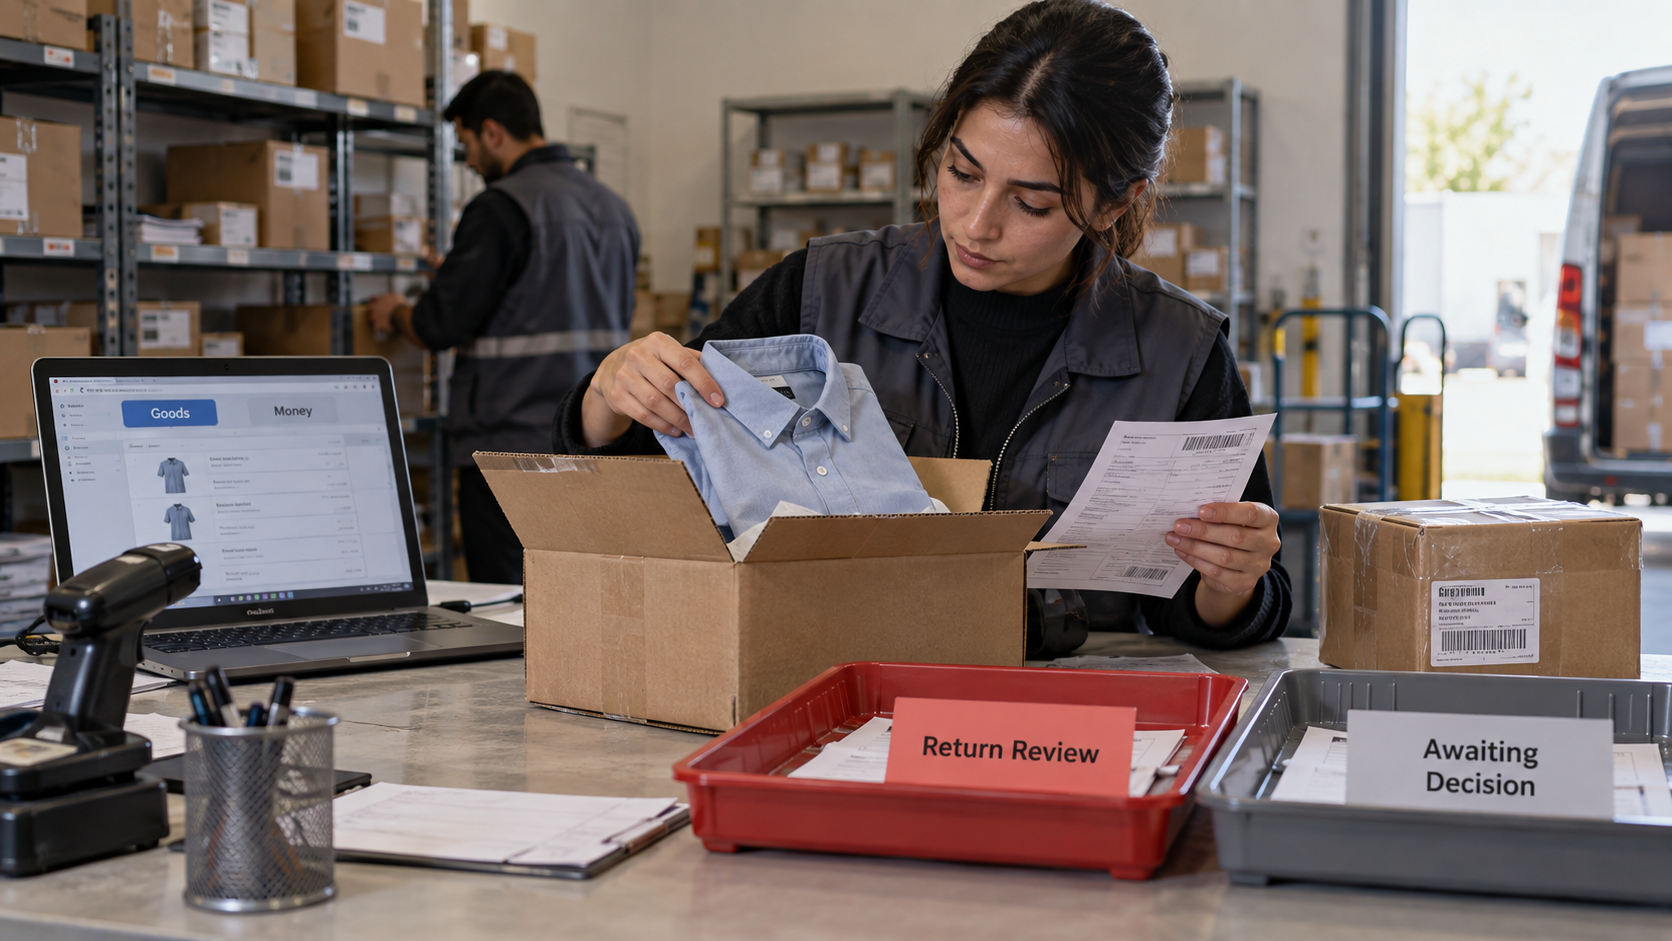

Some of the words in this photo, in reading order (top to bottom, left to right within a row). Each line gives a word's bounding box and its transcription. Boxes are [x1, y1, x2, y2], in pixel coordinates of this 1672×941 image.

[150, 407, 191, 419] Goods
[274, 405, 313, 418] Money
[923, 736, 1002, 759] Return
[1012, 740, 1099, 763] Review
[1423, 739, 1538, 769] Awaiting
[1427, 771, 1534, 796] Decision
